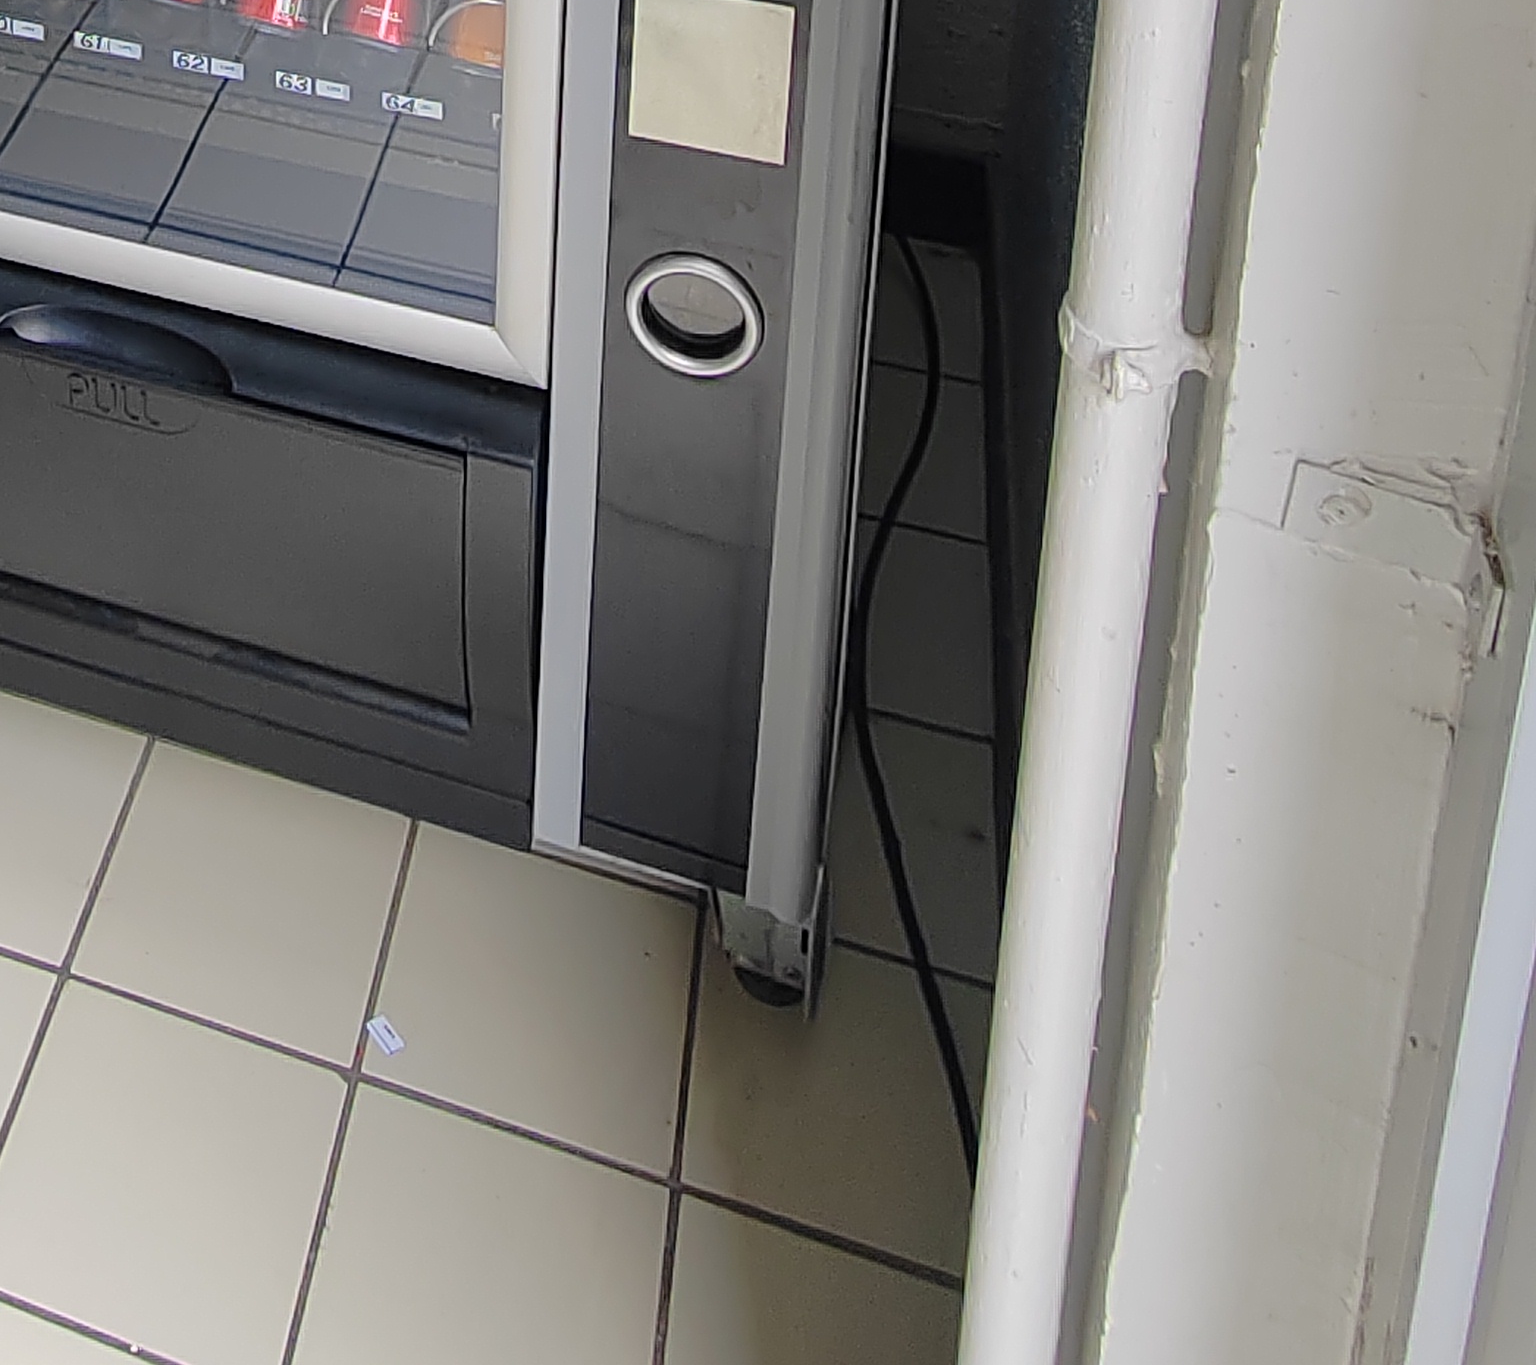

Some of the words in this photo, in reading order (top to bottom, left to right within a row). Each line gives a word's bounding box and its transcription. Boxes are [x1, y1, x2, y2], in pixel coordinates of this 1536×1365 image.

[81, 31, 104, 49] 61
[176, 53, 206, 70] 62
[279, 73, 309, 93] 63
[386, 94, 416, 113] 64
[67, 371, 162, 427] PULL
